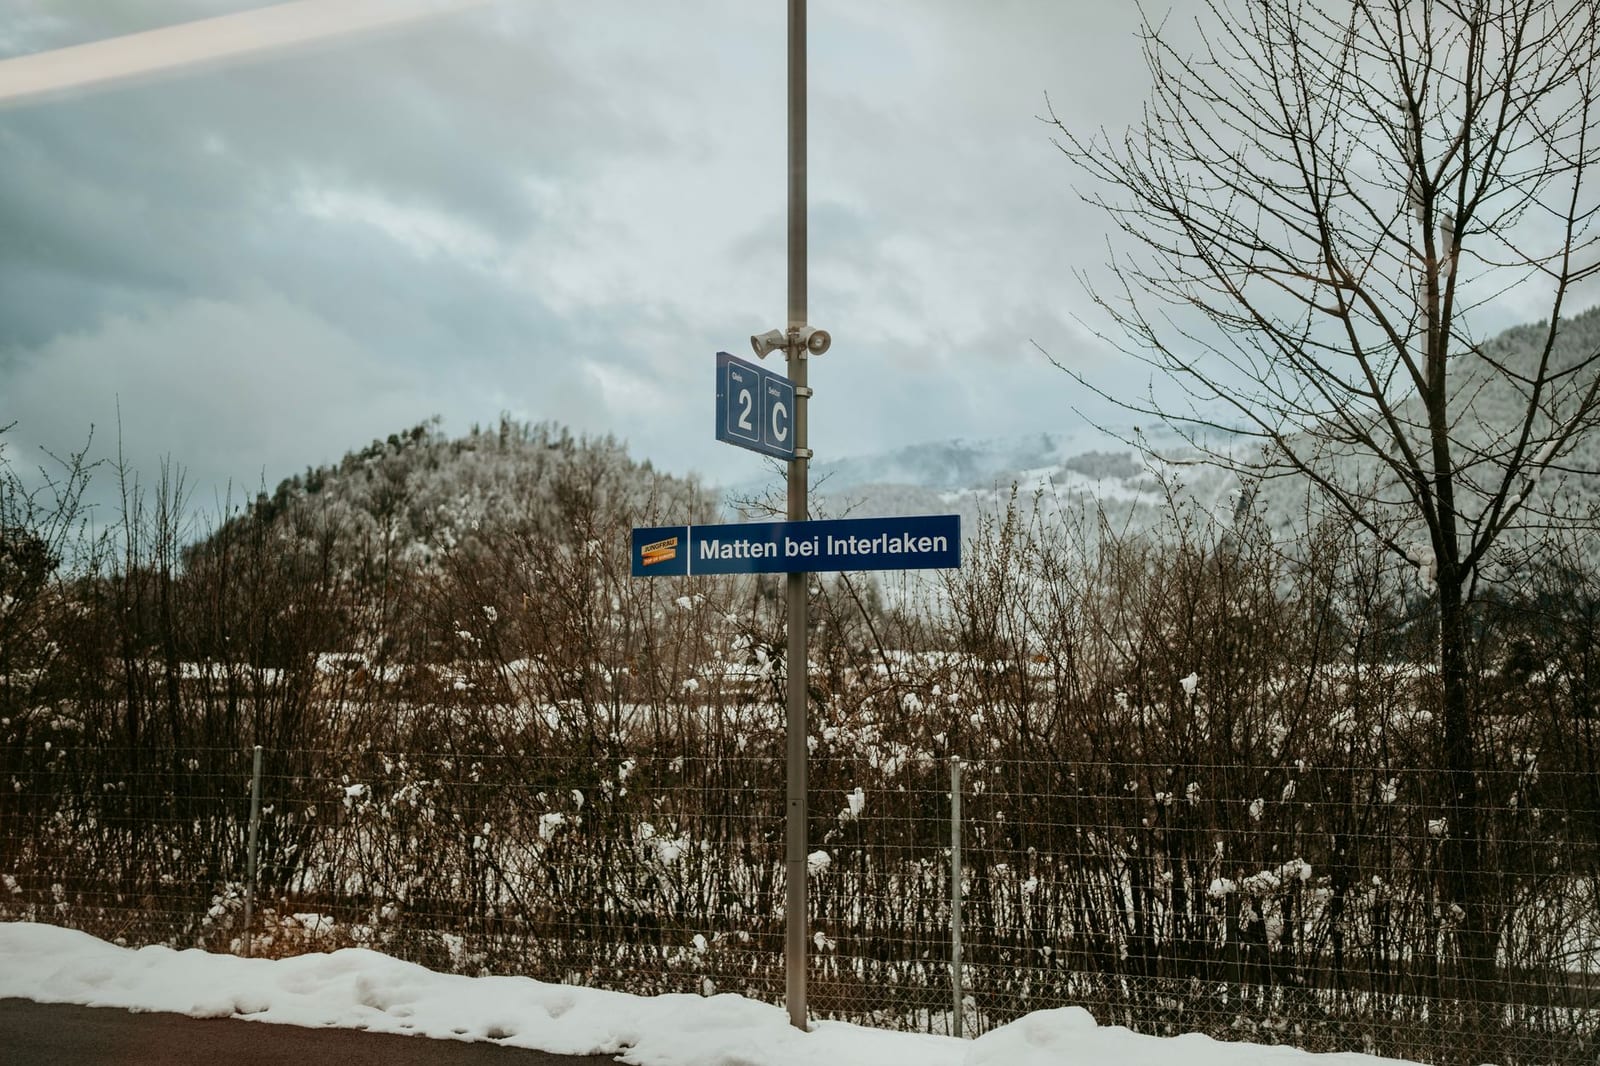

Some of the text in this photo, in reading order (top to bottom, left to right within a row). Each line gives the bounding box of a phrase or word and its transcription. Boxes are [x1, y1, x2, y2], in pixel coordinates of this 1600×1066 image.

[738, 388, 752, 431] 2
[772, 401, 788, 442] C
[644, 539, 675, 553] JUNGFRAU
[700, 532, 948, 560] Matten bei Interlaken
